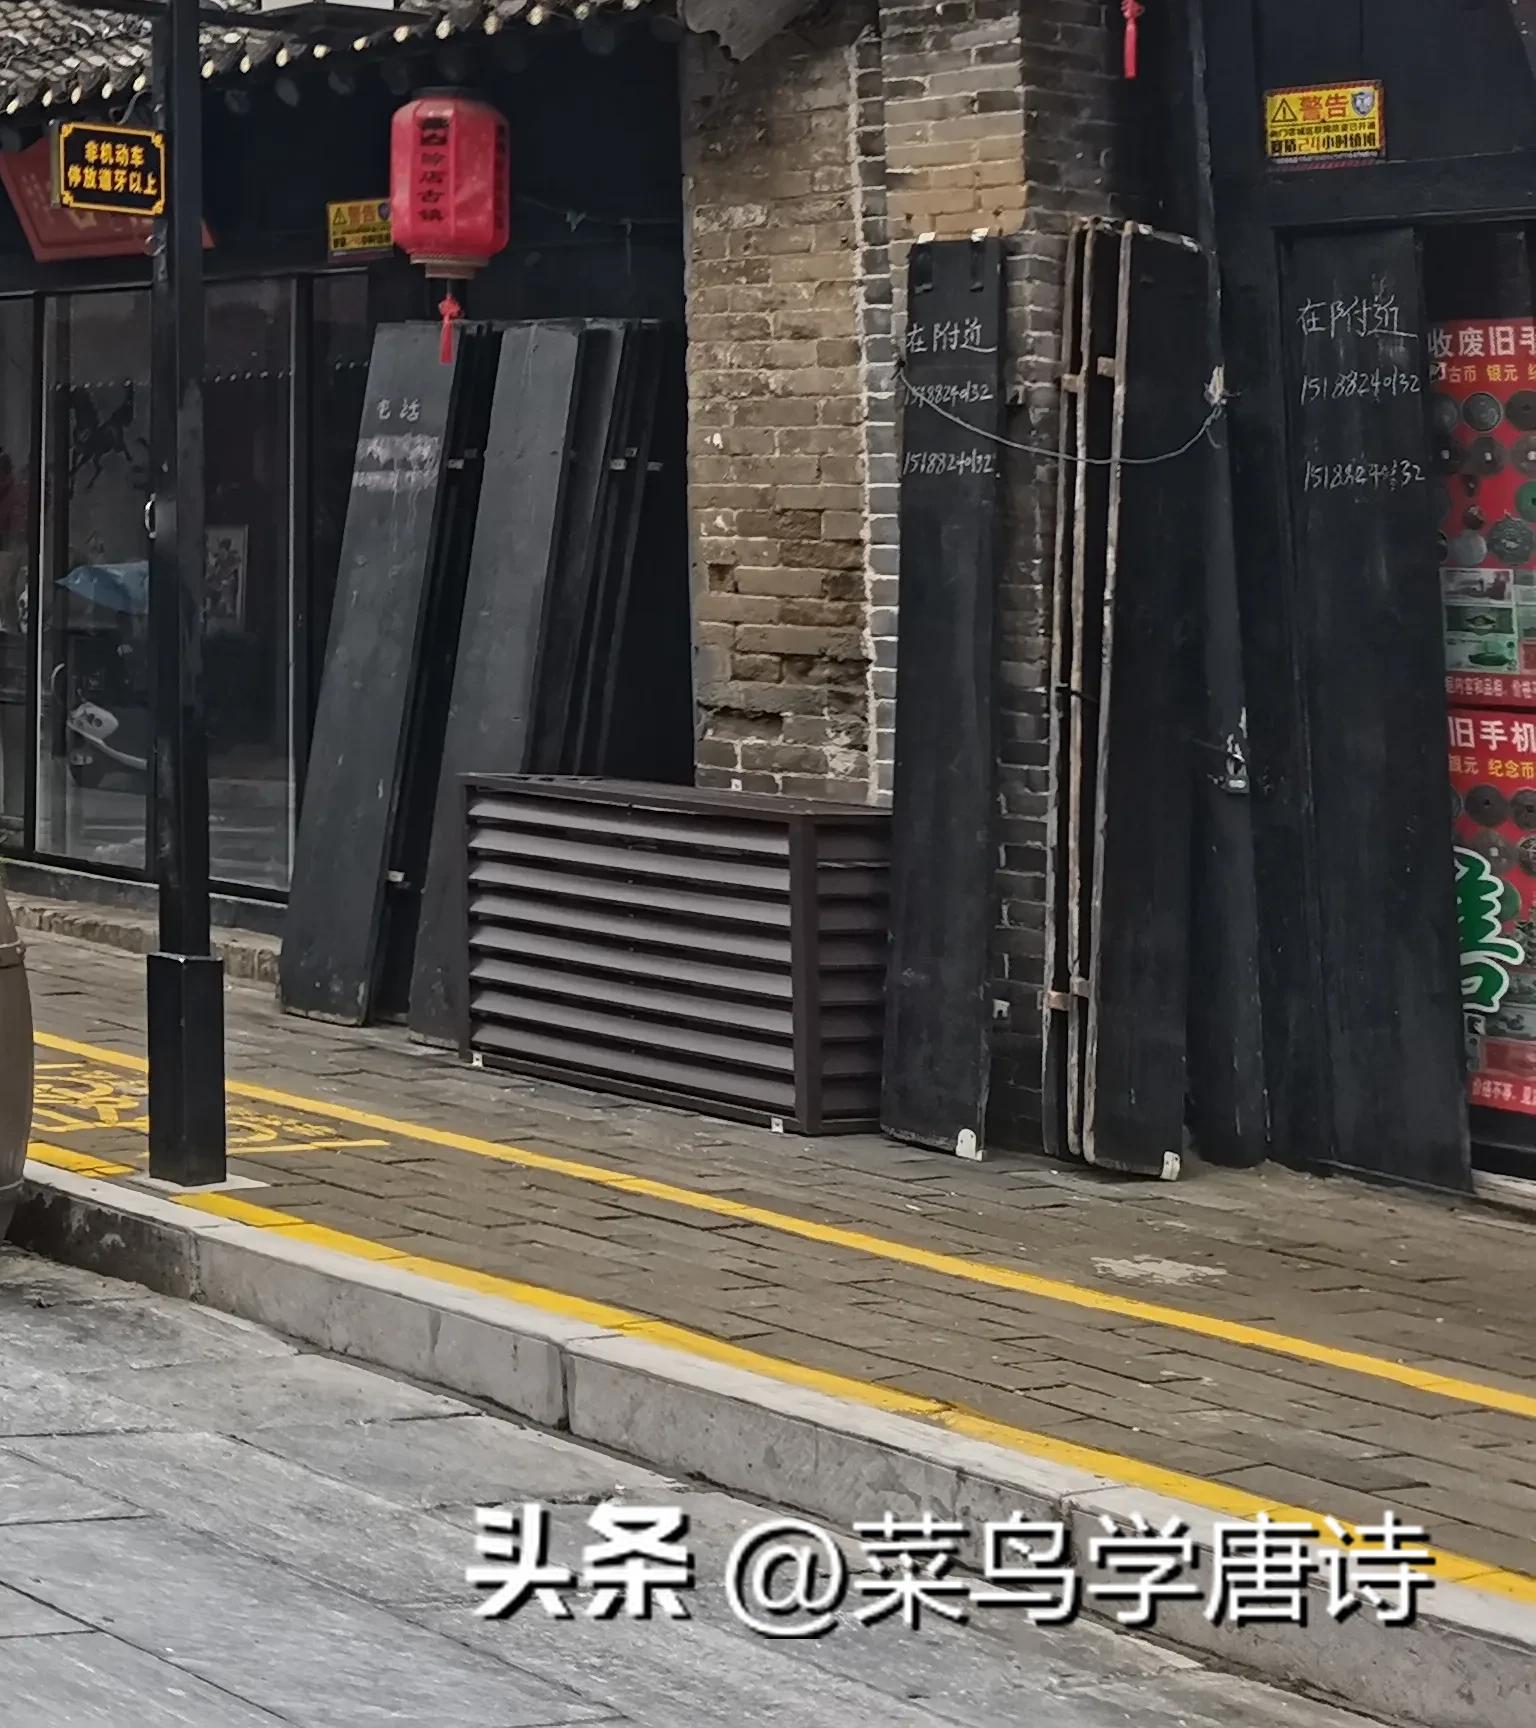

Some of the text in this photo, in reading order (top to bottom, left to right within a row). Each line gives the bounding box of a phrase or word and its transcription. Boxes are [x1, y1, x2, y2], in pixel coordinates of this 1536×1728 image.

[1299, 94, 1349, 122] 警告
[84, 139, 145, 168] 非机动车
[67, 164, 158, 196] 停放道牙以上
[1297, 293, 1418, 339] 在附近
[905, 317, 998, 353] 在附近
[1447, 364, 1477, 383] 古币
[1486, 363, 1519, 383] 银元
[1447, 715, 1536, 754] 旧手机
[1488, 758, 1535, 780] 纪念币
